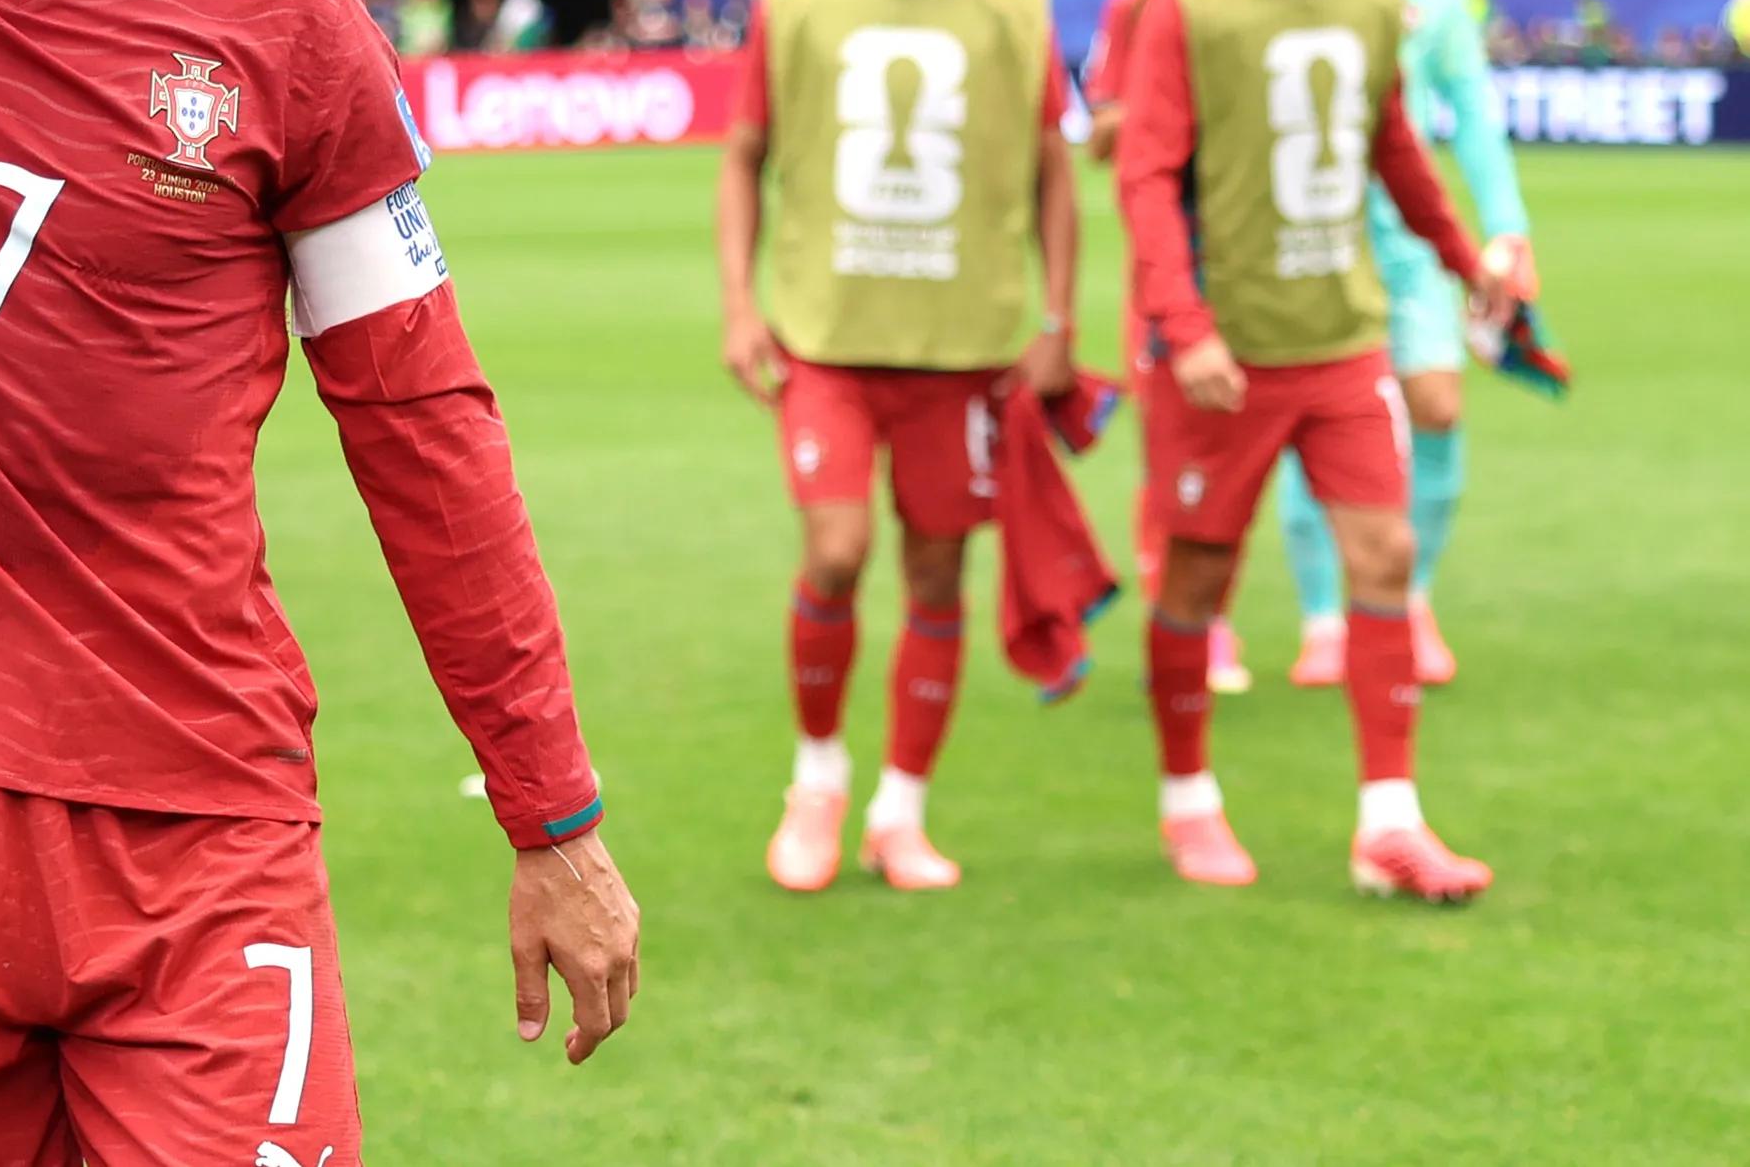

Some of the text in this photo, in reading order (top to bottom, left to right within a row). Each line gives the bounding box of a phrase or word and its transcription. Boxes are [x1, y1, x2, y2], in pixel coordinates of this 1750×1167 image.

[424, 58, 694, 149] Lenovo
[1488, 66, 1728, 145] TREET
[141, 168, 156, 181] 23
[158, 173, 192, 189] JUNHO
[195, 179, 219, 194] 2026
[154, 183, 206, 203] HOUSTON
[386, 180, 418, 215] FOOT
[243, 942, 314, 1125] 7
